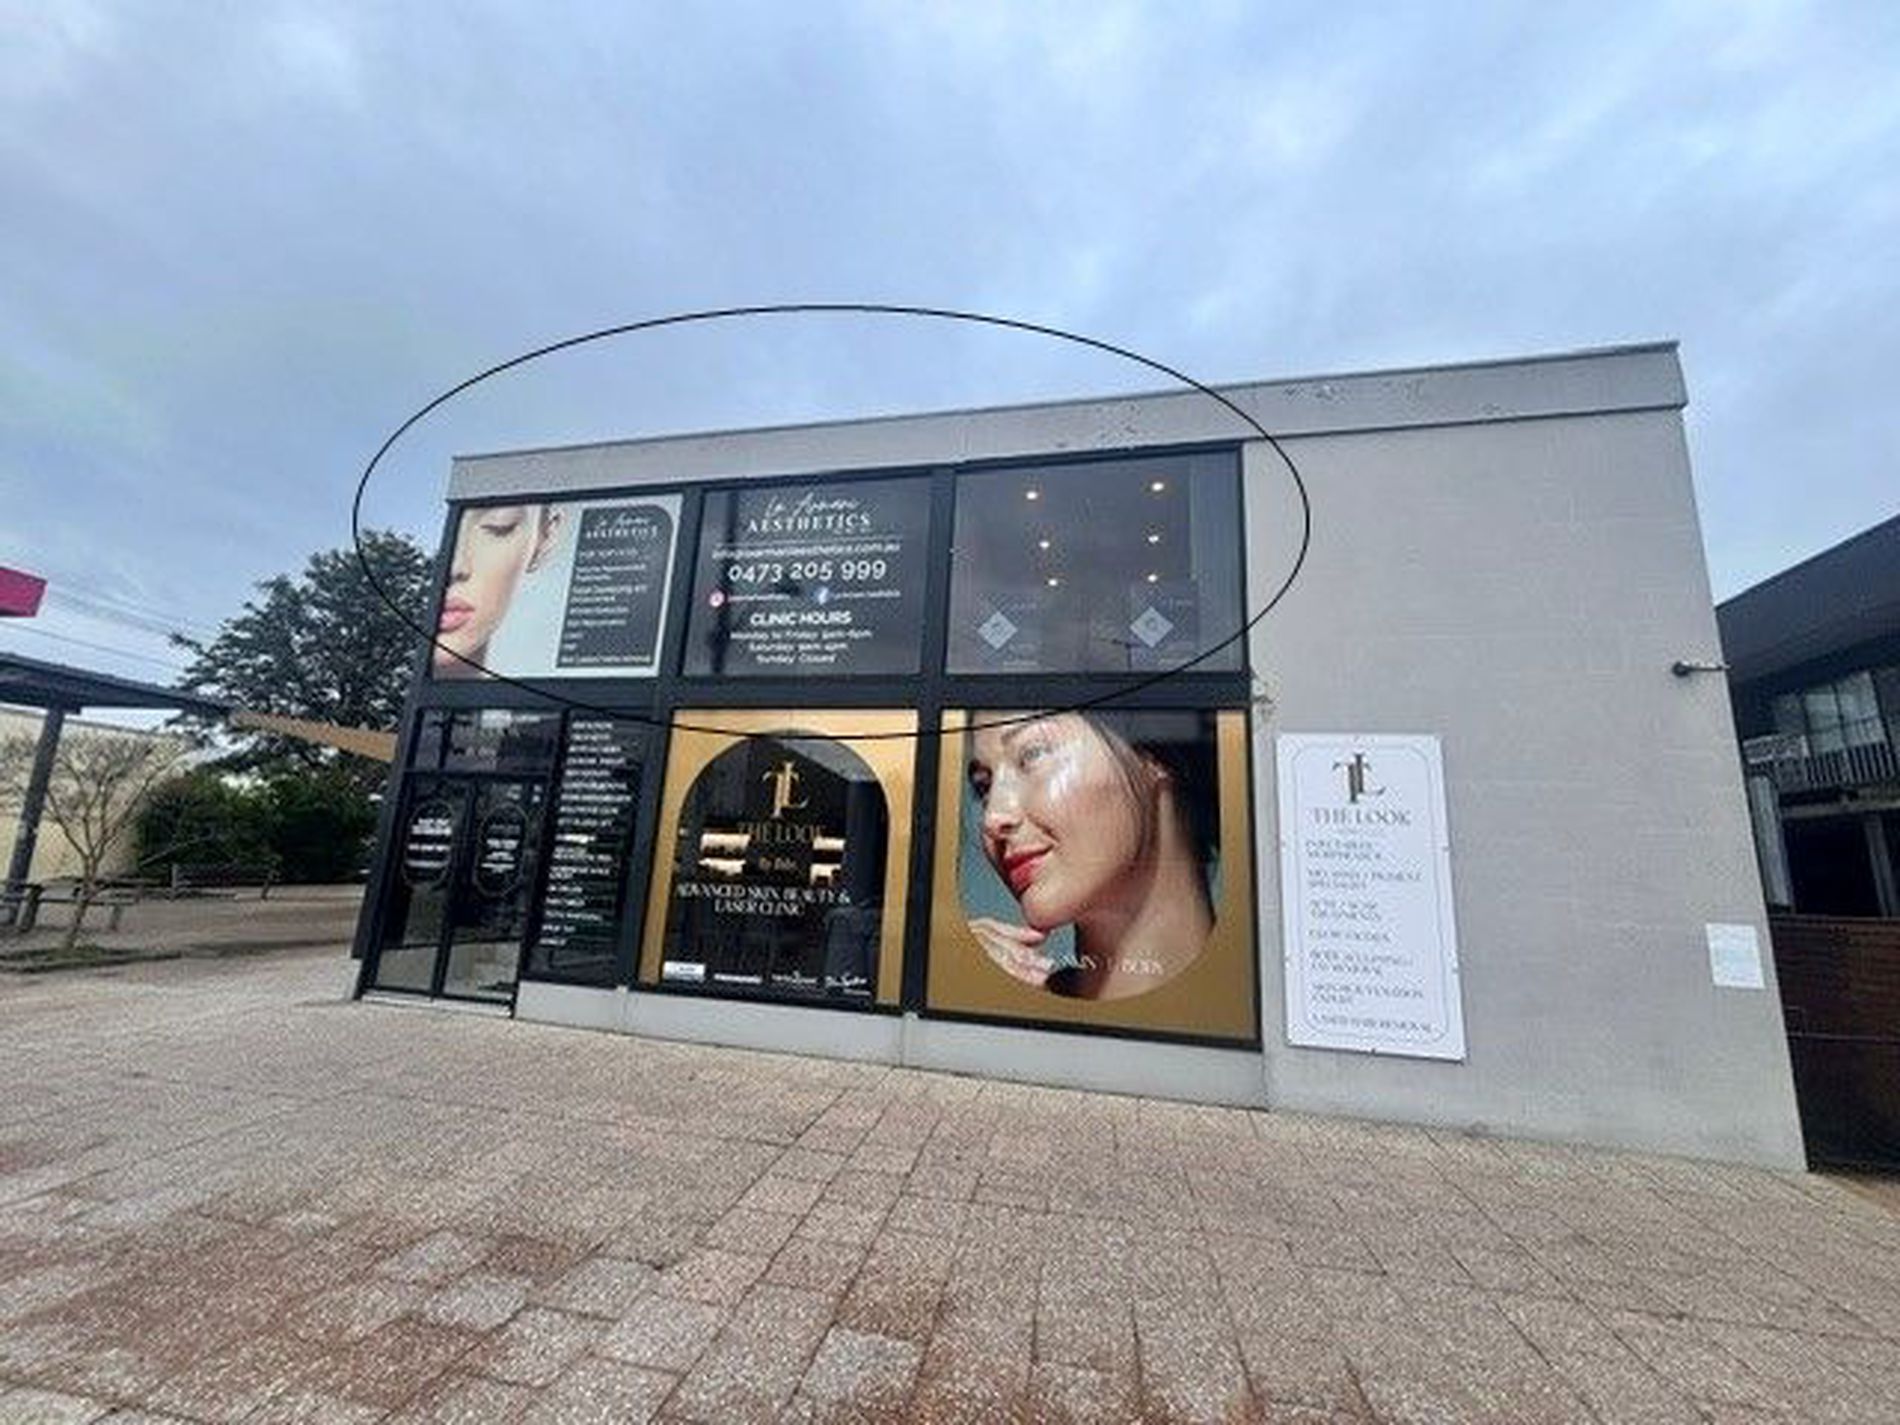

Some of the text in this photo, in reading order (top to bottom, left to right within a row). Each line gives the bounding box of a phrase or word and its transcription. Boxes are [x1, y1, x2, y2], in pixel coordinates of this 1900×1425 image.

[747, 513, 871, 533] AESTHETICS
[728, 559, 887, 583] 0473 205 999
[751, 611, 852, 626] CLINIC HOURS
[1354, 809, 1412, 826] LOOK
